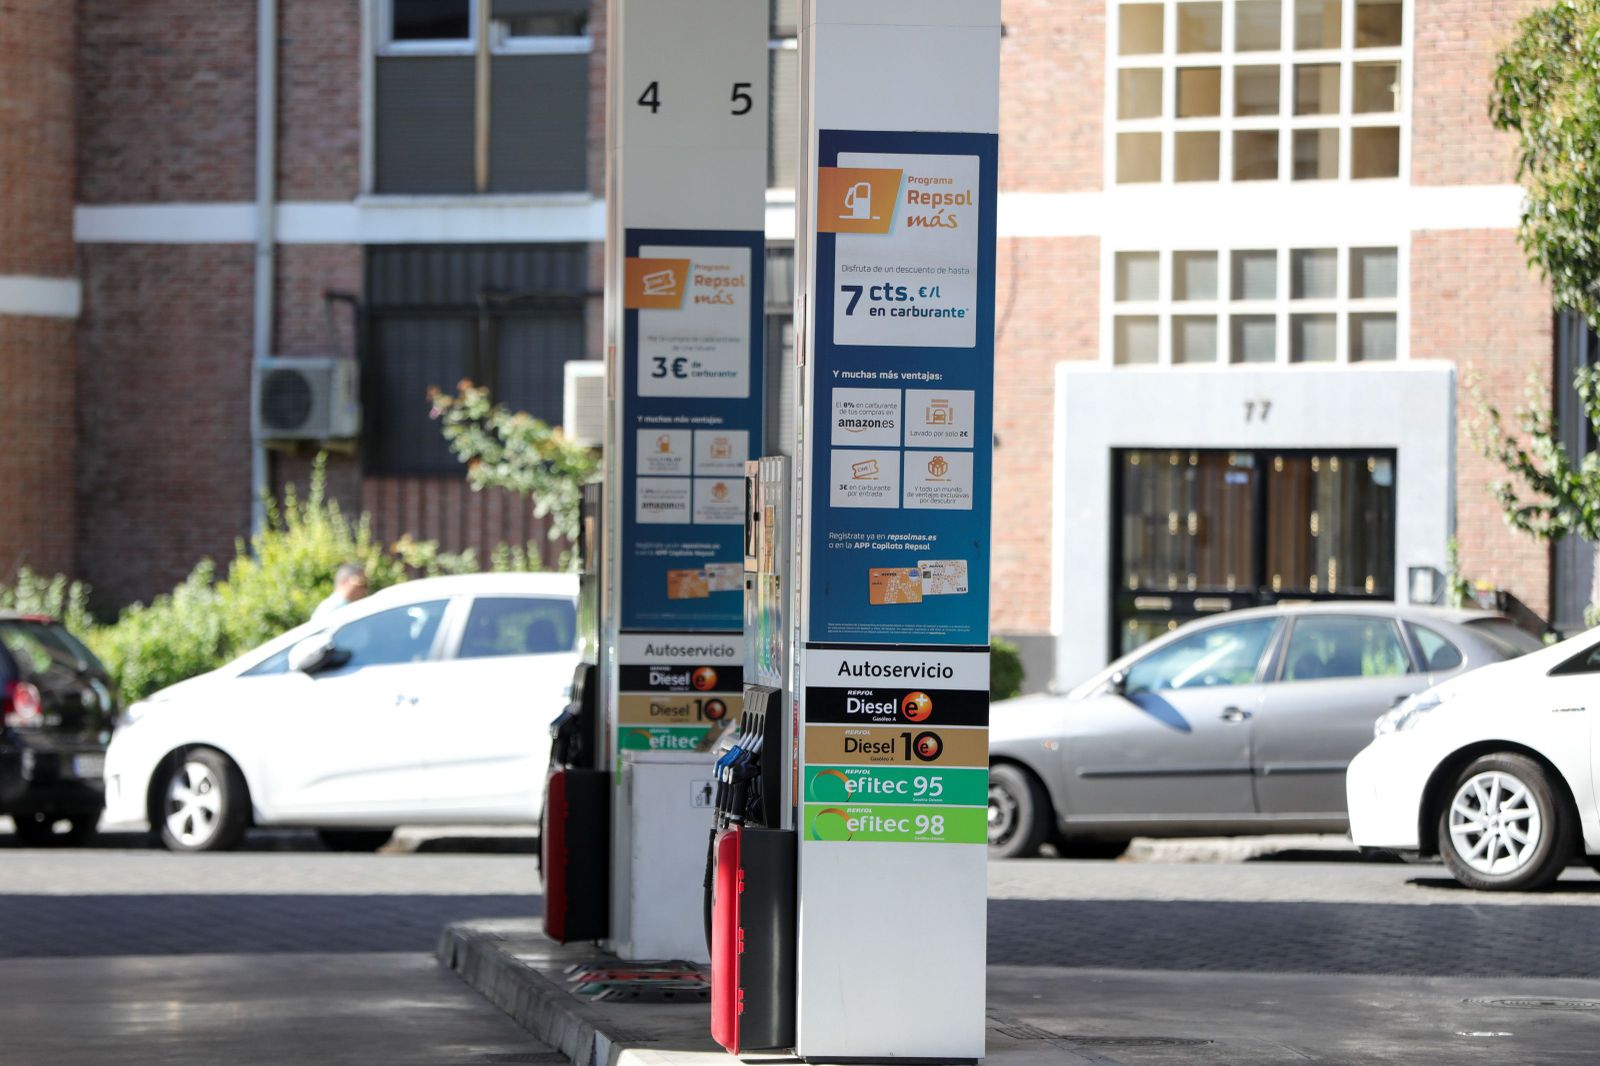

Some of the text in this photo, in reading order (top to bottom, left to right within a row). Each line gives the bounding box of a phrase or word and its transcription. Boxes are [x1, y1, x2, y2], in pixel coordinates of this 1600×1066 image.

[637, 81, 660, 114] 4
[731, 83, 752, 116] 5
[908, 176, 952, 186] Programa
[907, 189, 972, 208] Repsol
[907, 209, 957, 229] más
[841, 265, 871, 273] Disfruta
[873, 265, 882, 273] de
[896, 265, 935, 274] descuento
[937, 266, 946, 274] de
[949, 267, 970, 275] hasta
[694, 275, 745, 288] Repsol
[694, 289, 735, 305] más
[841, 285, 863, 316] 7
[870, 282, 914, 302] cts.
[870, 307, 885, 316] en
[833, 370, 943, 381] Y muchas más ventajas:
[1244, 400, 1272, 422] 77
[838, 418, 894, 428] amazon.es
[887, 533, 937, 542] repsolmas.es
[872, 542, 903, 551] Copiloto
[905, 543, 930, 552] Repsol
[644, 643, 735, 658] Autoservicio
[838, 660, 953, 679] Autoservicio
[649, 672, 690, 686] Diesel
[650, 698, 727, 721] Diesel 10
[846, 697, 897, 714] Diesel
[649, 735, 699, 749] efitec
[844, 731, 943, 761] Diesel 10
[844, 776, 943, 797] efitec 95
[847, 815, 944, 835] efitec 98
